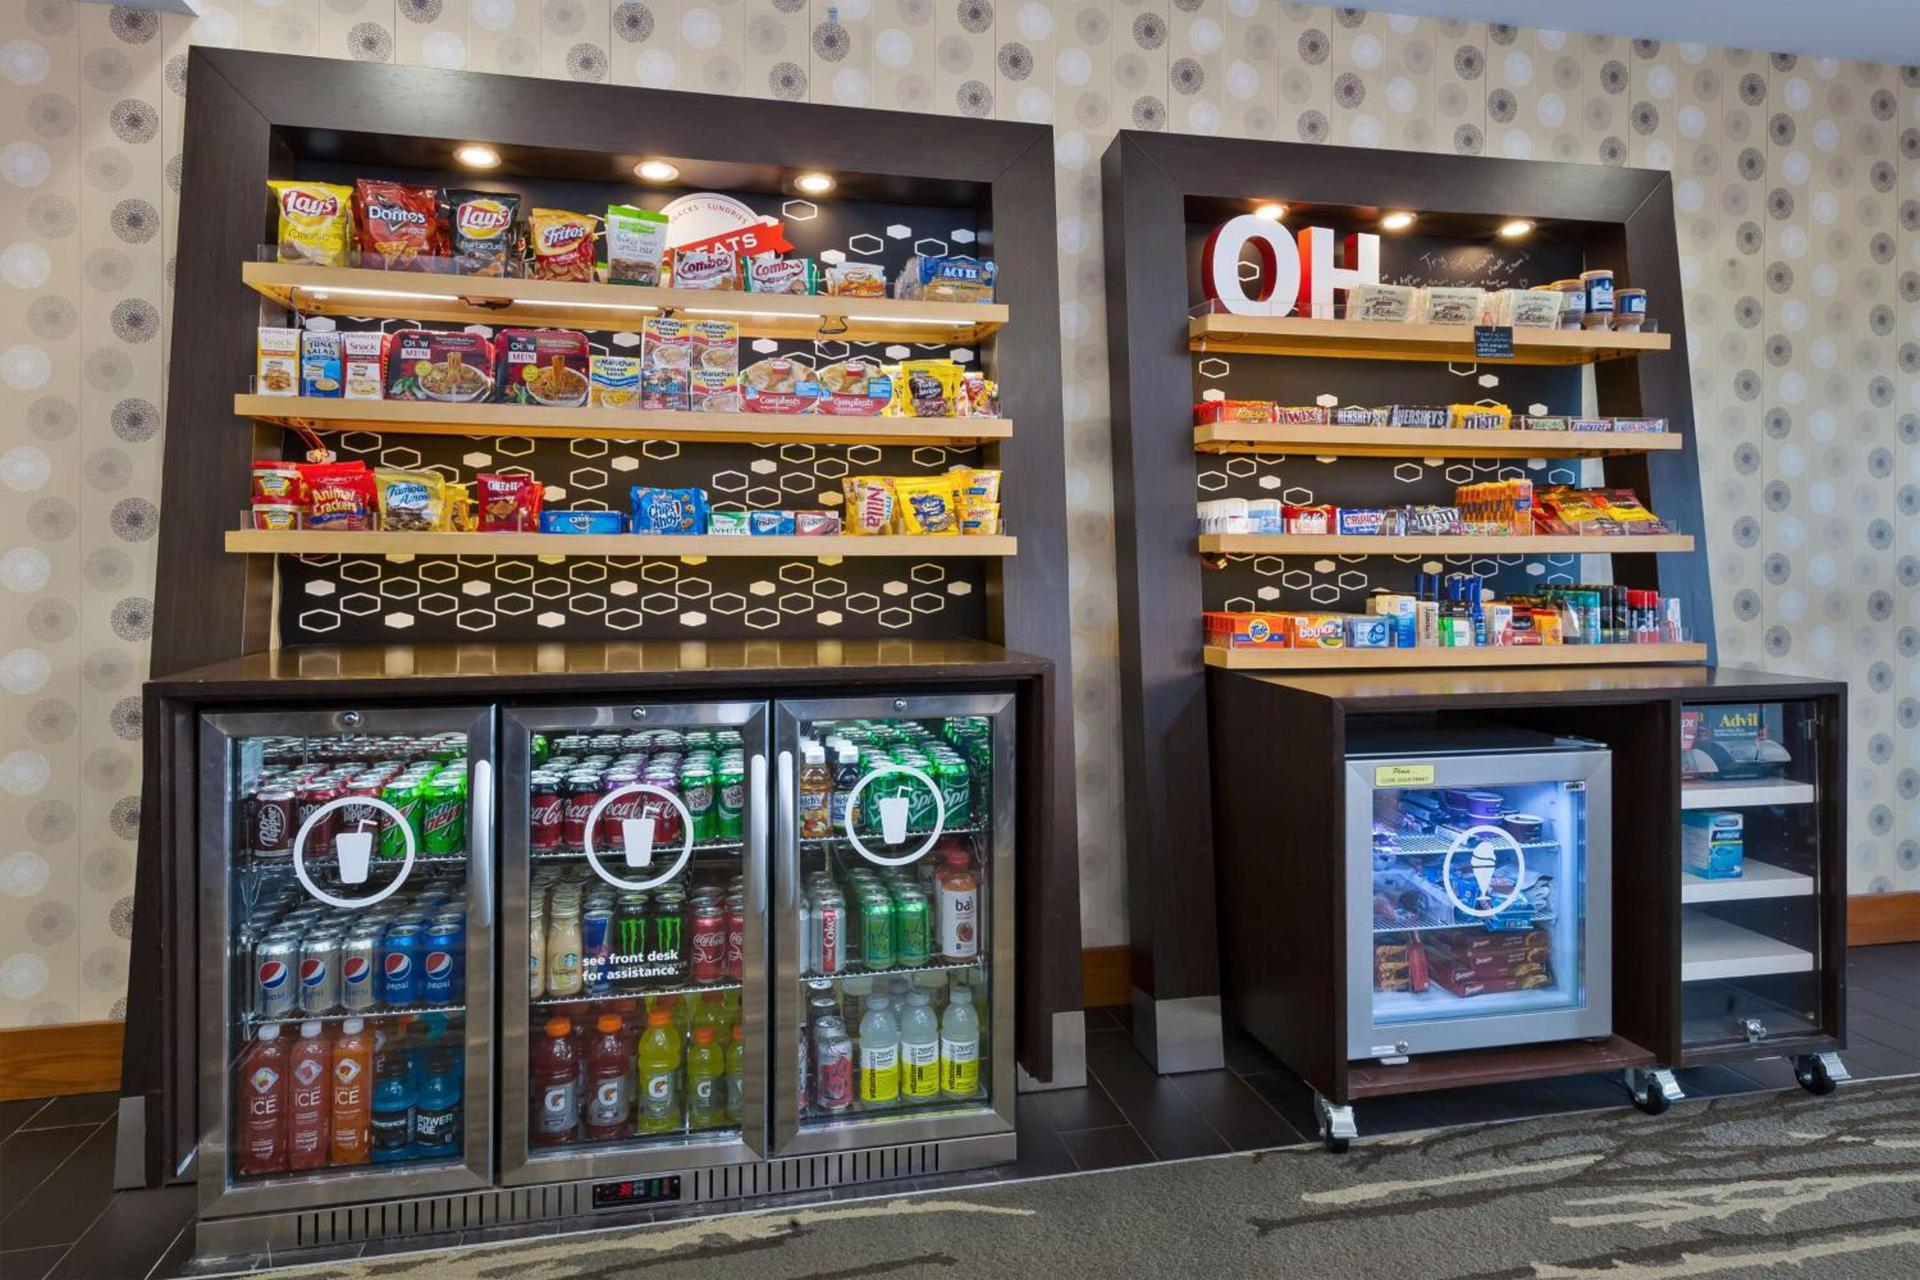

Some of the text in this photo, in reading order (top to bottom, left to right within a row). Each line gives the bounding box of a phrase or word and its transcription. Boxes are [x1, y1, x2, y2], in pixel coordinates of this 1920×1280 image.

[286, 191, 336, 217] Lay's
[368, 205, 426, 224] Doritos
[461, 206, 509, 227] Lay's
[706, 203, 747, 224] SUNDRIES
[543, 226, 585, 246] Fritos
[681, 255, 732, 273] Combos
[755, 260, 804, 277] Combos
[1204, 214, 1380, 319] OH
[944, 267, 977, 279] ACT II
[655, 319, 688, 329] Maruchan
[702, 322, 734, 331] Maruchan
[309, 340, 333, 349] TUNA
[350, 342, 376, 351] Snack
[307, 348, 336, 357] SALAD
[405, 350, 428, 359] MEIN
[512, 353, 535, 362] MEIN
[601, 358, 636, 368] Maruchan
[701, 370, 734, 378] Maruchan
[1397, 408, 1444, 426] HERSHEY'S
[312, 485, 356, 502] Animal
[387, 484, 427, 497] Famous
[400, 493, 429, 505] Amos
[313, 500, 358, 516] Crackers
[649, 501, 676, 519] Chips
[866, 487, 885, 528] Nilla
[1345, 515, 1381, 526] CRUNCH
[1251, 624, 1268, 637] Tide
[1301, 624, 1336, 638] bounce
[1720, 712, 1758, 727] Advil
[823, 909, 837, 948] Coke
[583, 957, 605, 966] see
[609, 951, 645, 964] front
[647, 949, 679, 961] desk
[582, 971, 603, 981] for
[606, 965, 679, 980] assistance.
[386, 981, 409, 991] pepsi
[427, 981, 450, 990] pepsi
[877, 1049, 895, 1059] zero
[917, 1045, 935, 1055] zero
[597, 1082, 618, 1105] G
[648, 1075, 669, 1098] G
[697, 1080, 711, 1098] G
[294, 1090, 321, 1107] ICE
[335, 1089, 360, 1105] ICE
[545, 1088, 566, 1112] G
[250, 1100, 277, 1115] ICE
[416, 1113, 453, 1127] POWER
